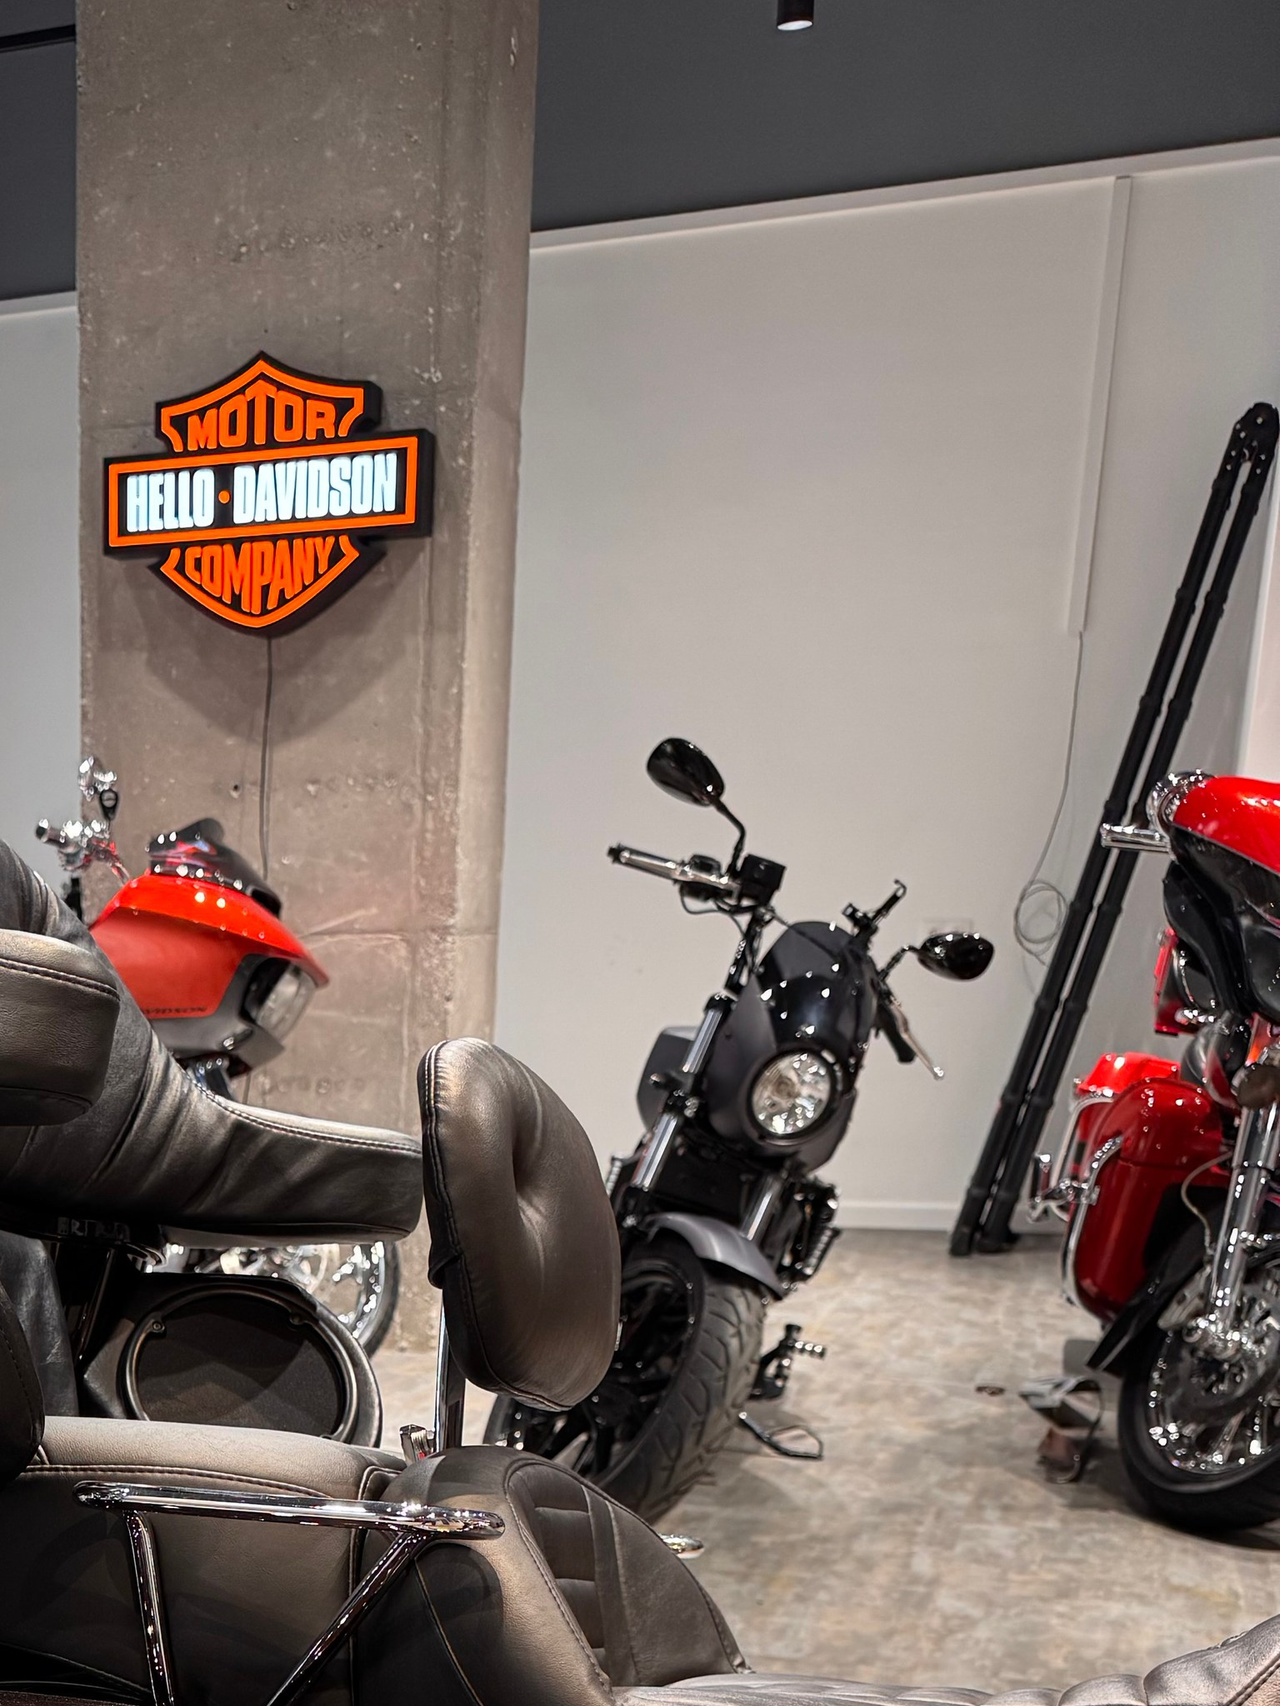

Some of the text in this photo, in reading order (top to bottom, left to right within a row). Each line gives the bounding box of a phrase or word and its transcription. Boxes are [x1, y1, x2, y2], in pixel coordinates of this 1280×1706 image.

[187, 379, 336, 451] MOTOR
[126, 452, 398, 533] HELLO DAVIDSON
[184, 535, 336, 615] COMPANY
